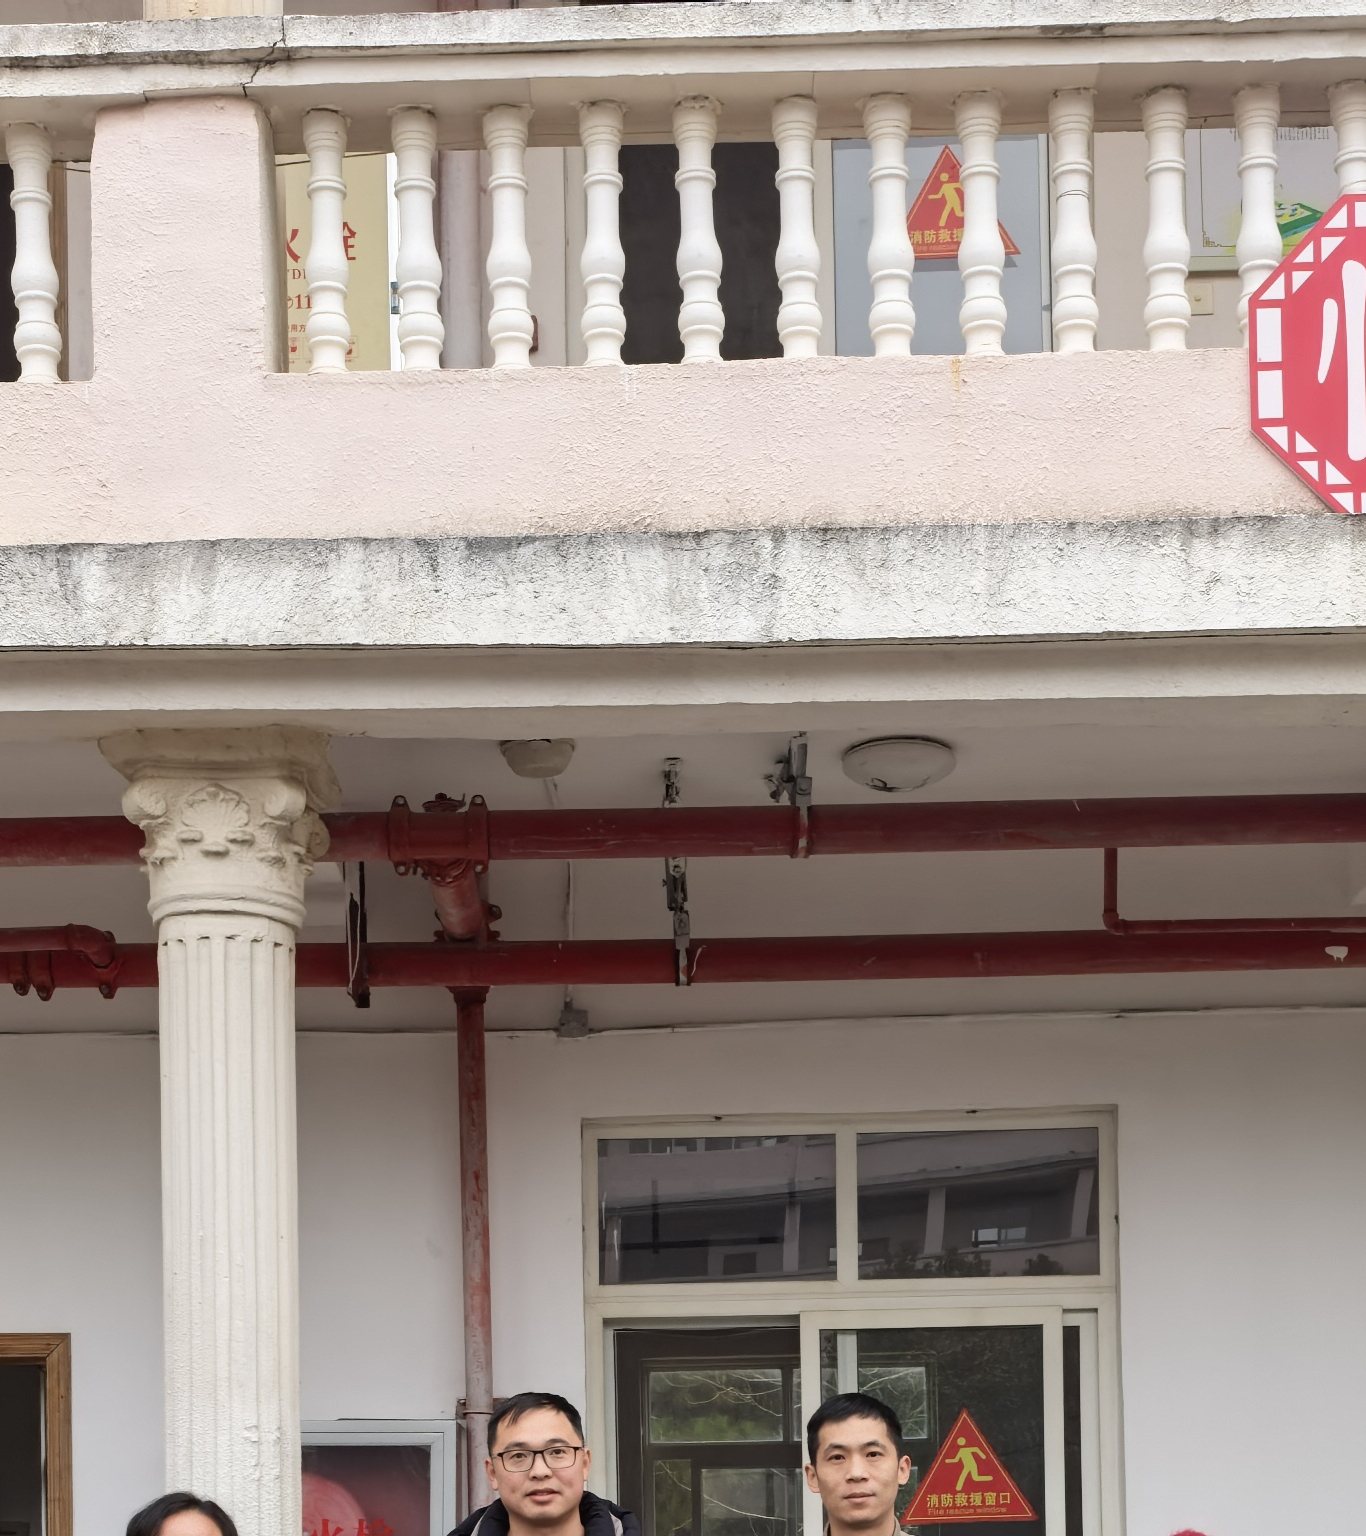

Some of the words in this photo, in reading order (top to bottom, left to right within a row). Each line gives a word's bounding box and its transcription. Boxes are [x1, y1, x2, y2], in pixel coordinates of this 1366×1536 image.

[926, 1491, 1010, 1508] 消防救援窗口
